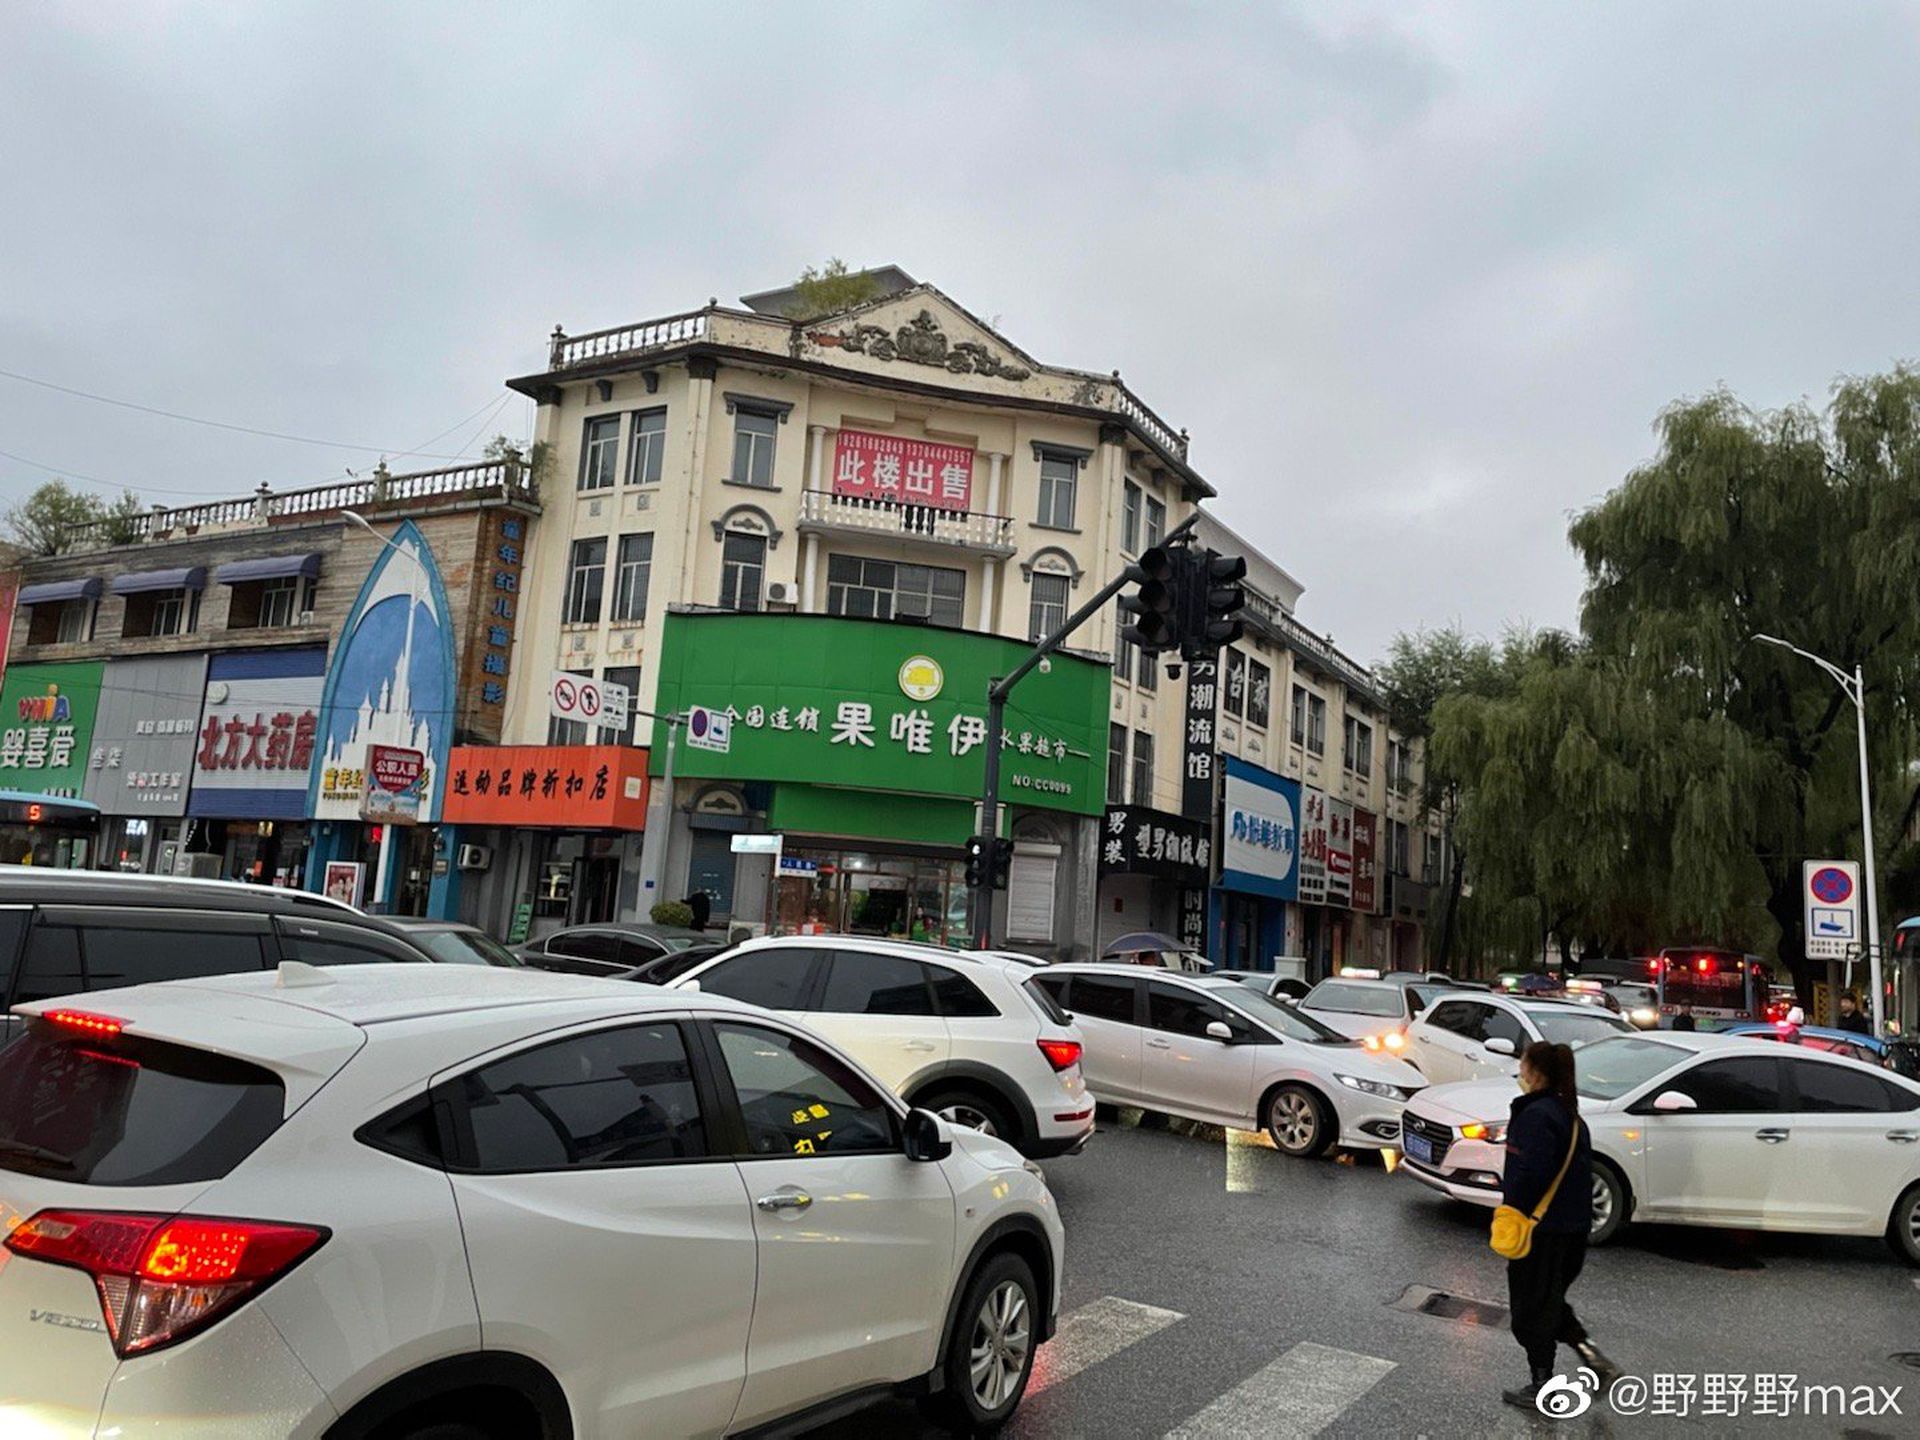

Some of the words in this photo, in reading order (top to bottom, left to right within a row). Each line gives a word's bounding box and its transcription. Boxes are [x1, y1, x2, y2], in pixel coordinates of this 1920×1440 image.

[837, 449, 969, 500] 此楼出售
[0, 725, 76, 769] 婴喜爱
[198, 709, 318, 771] 北方大药房
[830, 701, 989, 757] 果唯伊
[376, 759, 418, 777] 公职人员
[1103, 811, 1127, 864] 男装
